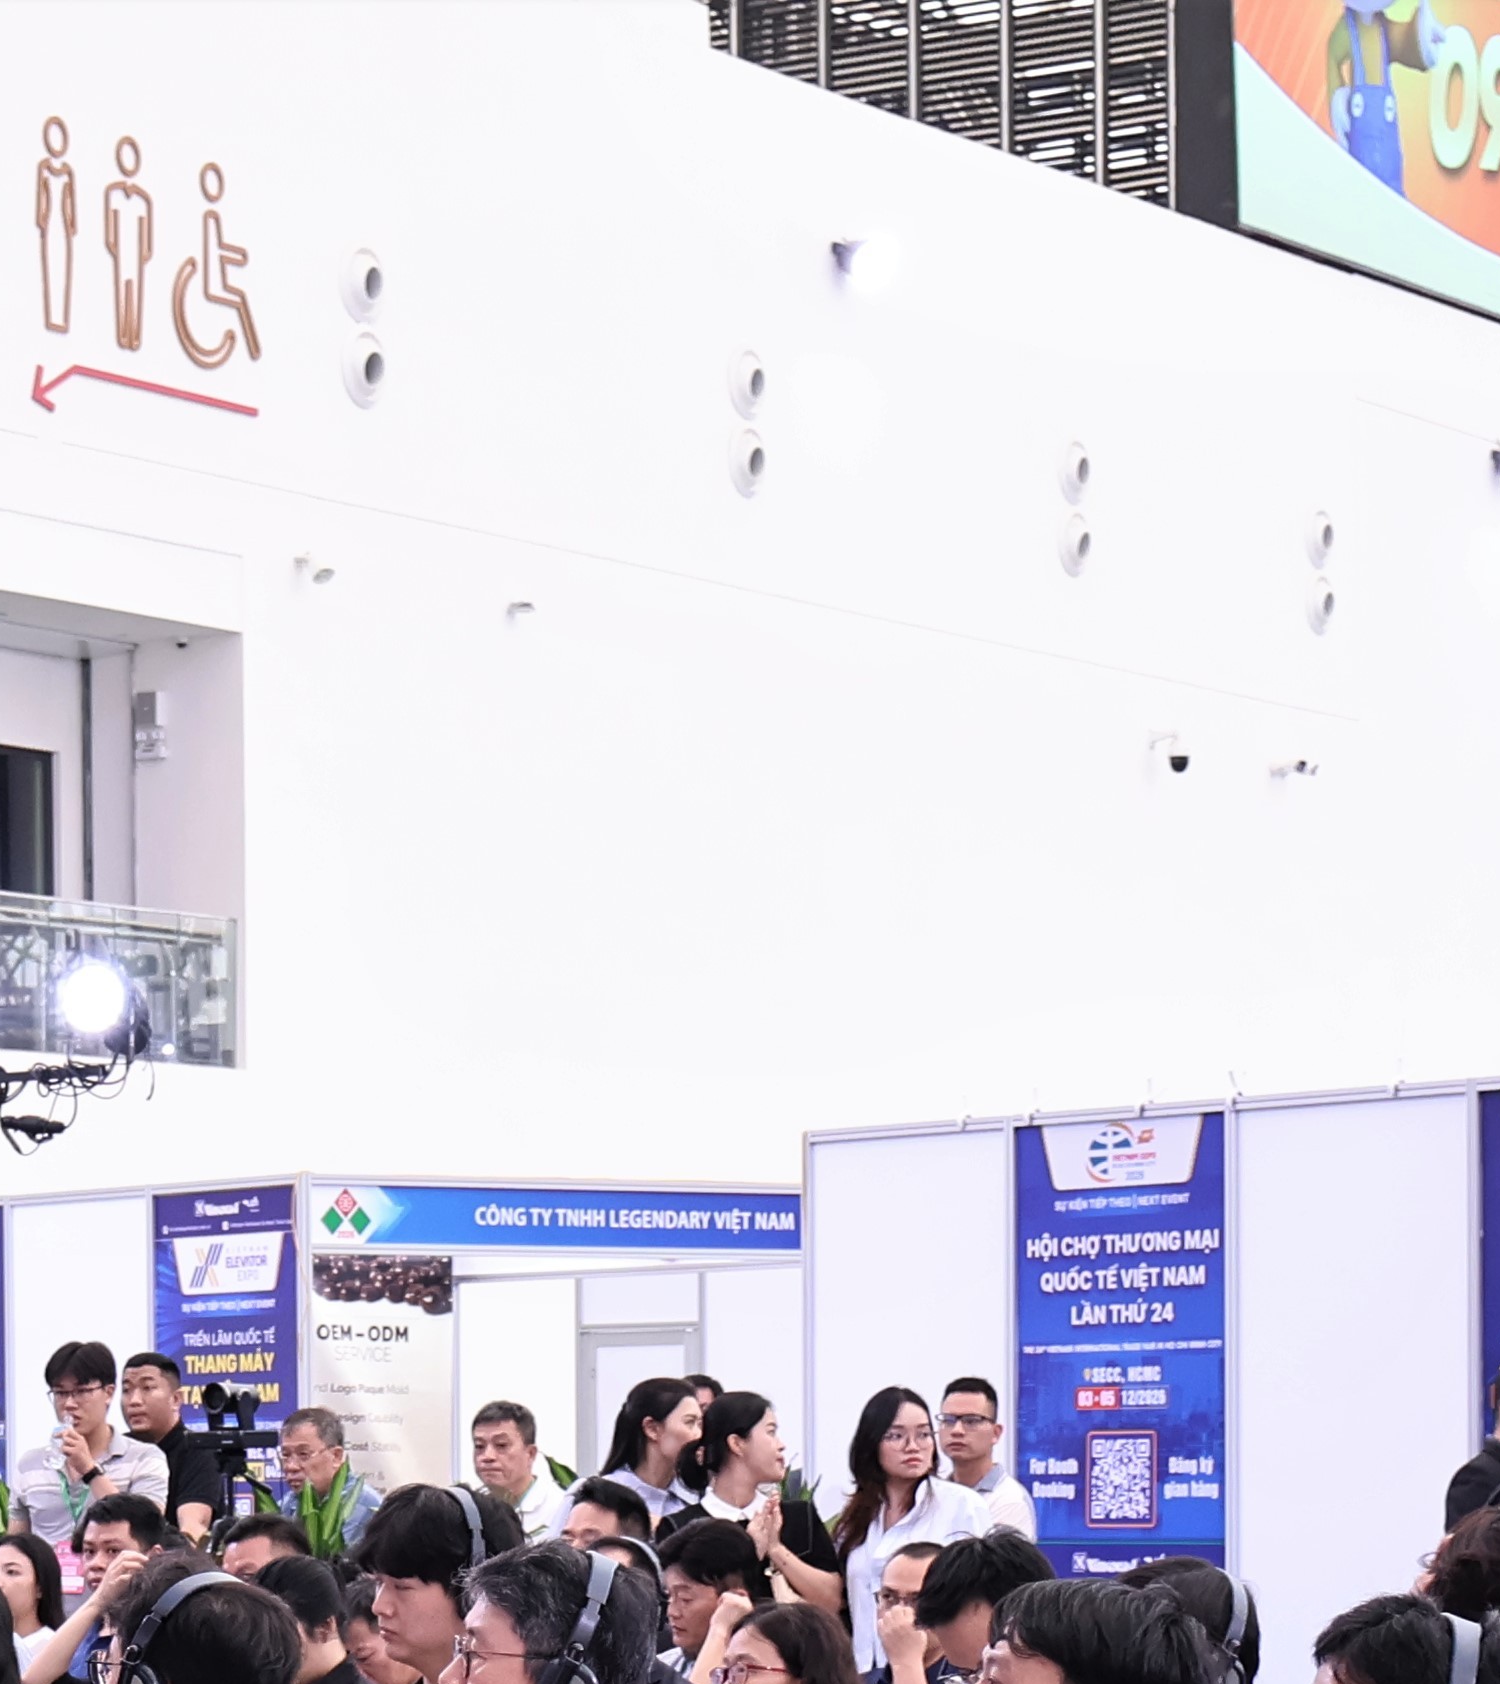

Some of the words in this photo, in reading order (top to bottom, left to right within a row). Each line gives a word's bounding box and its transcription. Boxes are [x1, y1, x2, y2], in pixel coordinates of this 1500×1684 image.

[474, 1203, 527, 1226] CÔNG
[530, 1208, 552, 1227] TY
[556, 1208, 606, 1228] TNHH
[610, 1210, 712, 1231] LEGENDARY
[713, 1208, 752, 1234] VIỆT
[755, 1213, 795, 1231] NAM
[1026, 1232, 1058, 1262] HỘI
[1061, 1234, 1100, 1260] CHỢ
[1103, 1230, 1182, 1256] THƯƠNG
[1184, 1228, 1220, 1254] MẠI
[1040, 1265, 1093, 1294] QUỐC
[1095, 1263, 1120, 1290] TẾ
[1120, 1262, 1161, 1292] VIỆT
[1163, 1265, 1206, 1287] NAM
[1070, 1300, 1107, 1326] LẦN
[1109, 1298, 1149, 1324] THỨ
[1151, 1302, 1174, 1323] 24
[316, 1324, 352, 1341] OEM
[368, 1326, 409, 1342] ODM
[184, 1354, 238, 1375] THANG
